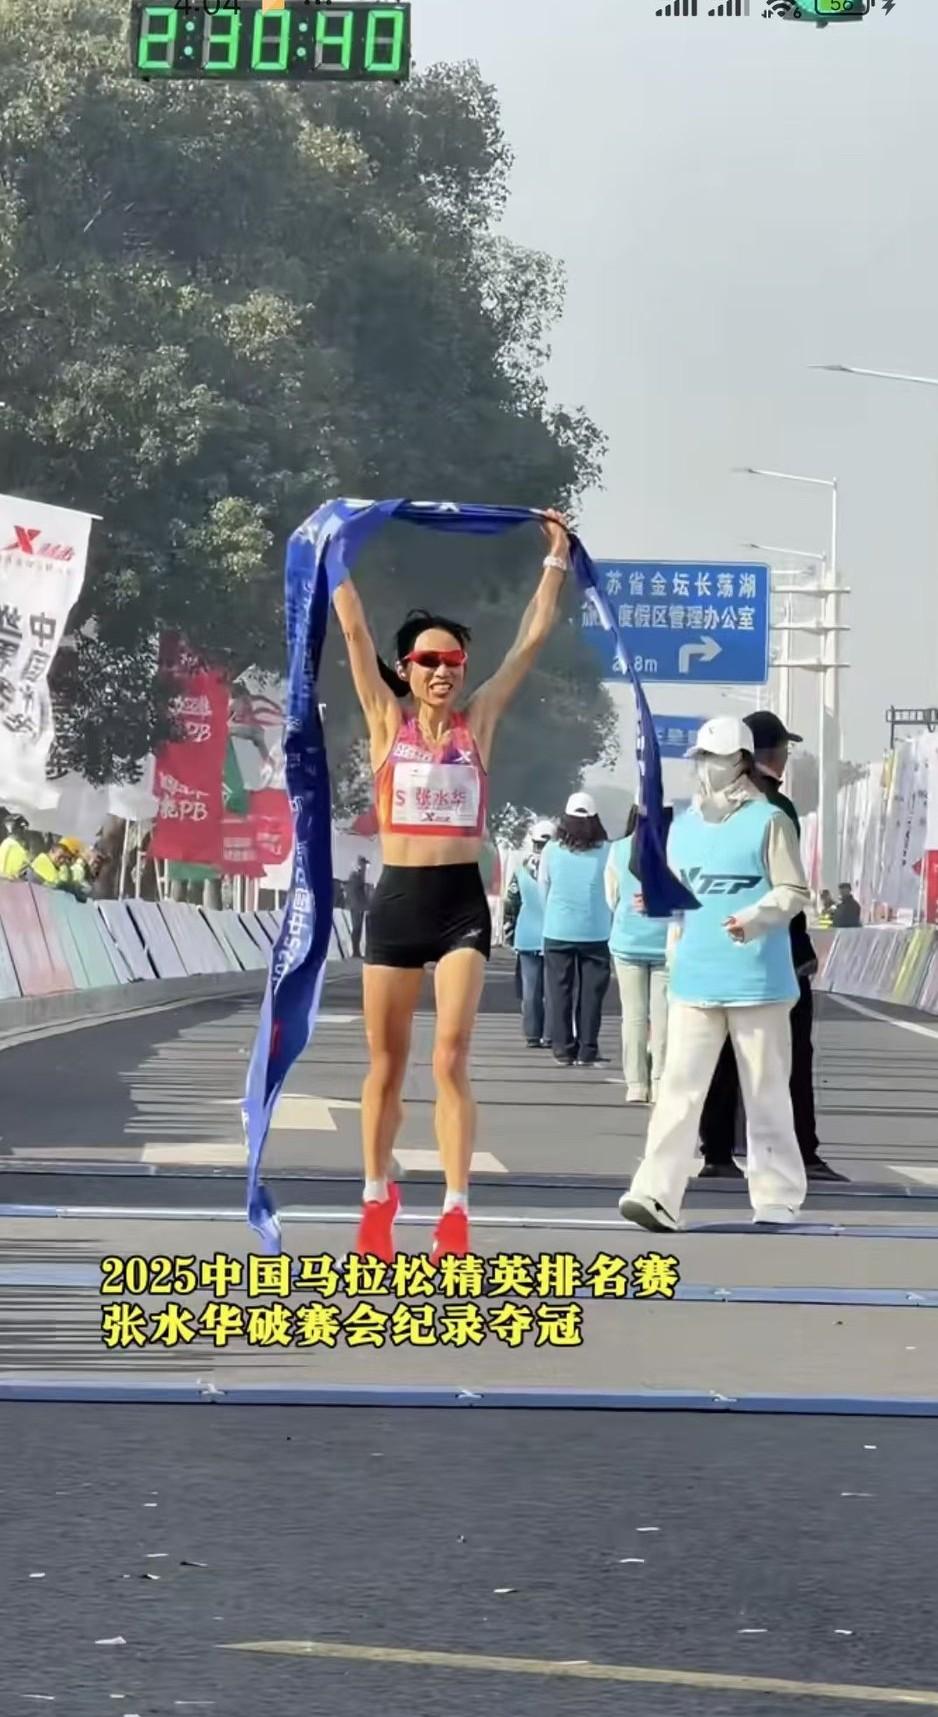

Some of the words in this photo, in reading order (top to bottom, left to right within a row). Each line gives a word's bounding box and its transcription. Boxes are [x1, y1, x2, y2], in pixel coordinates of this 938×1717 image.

[138, 8, 404, 71] 2:30:40
[605, 569, 757, 599] 苏省金坛长荡湖
[581, 602, 755, 631] 旅度假区管理办公室
[612, 654, 658, 672] 28m
